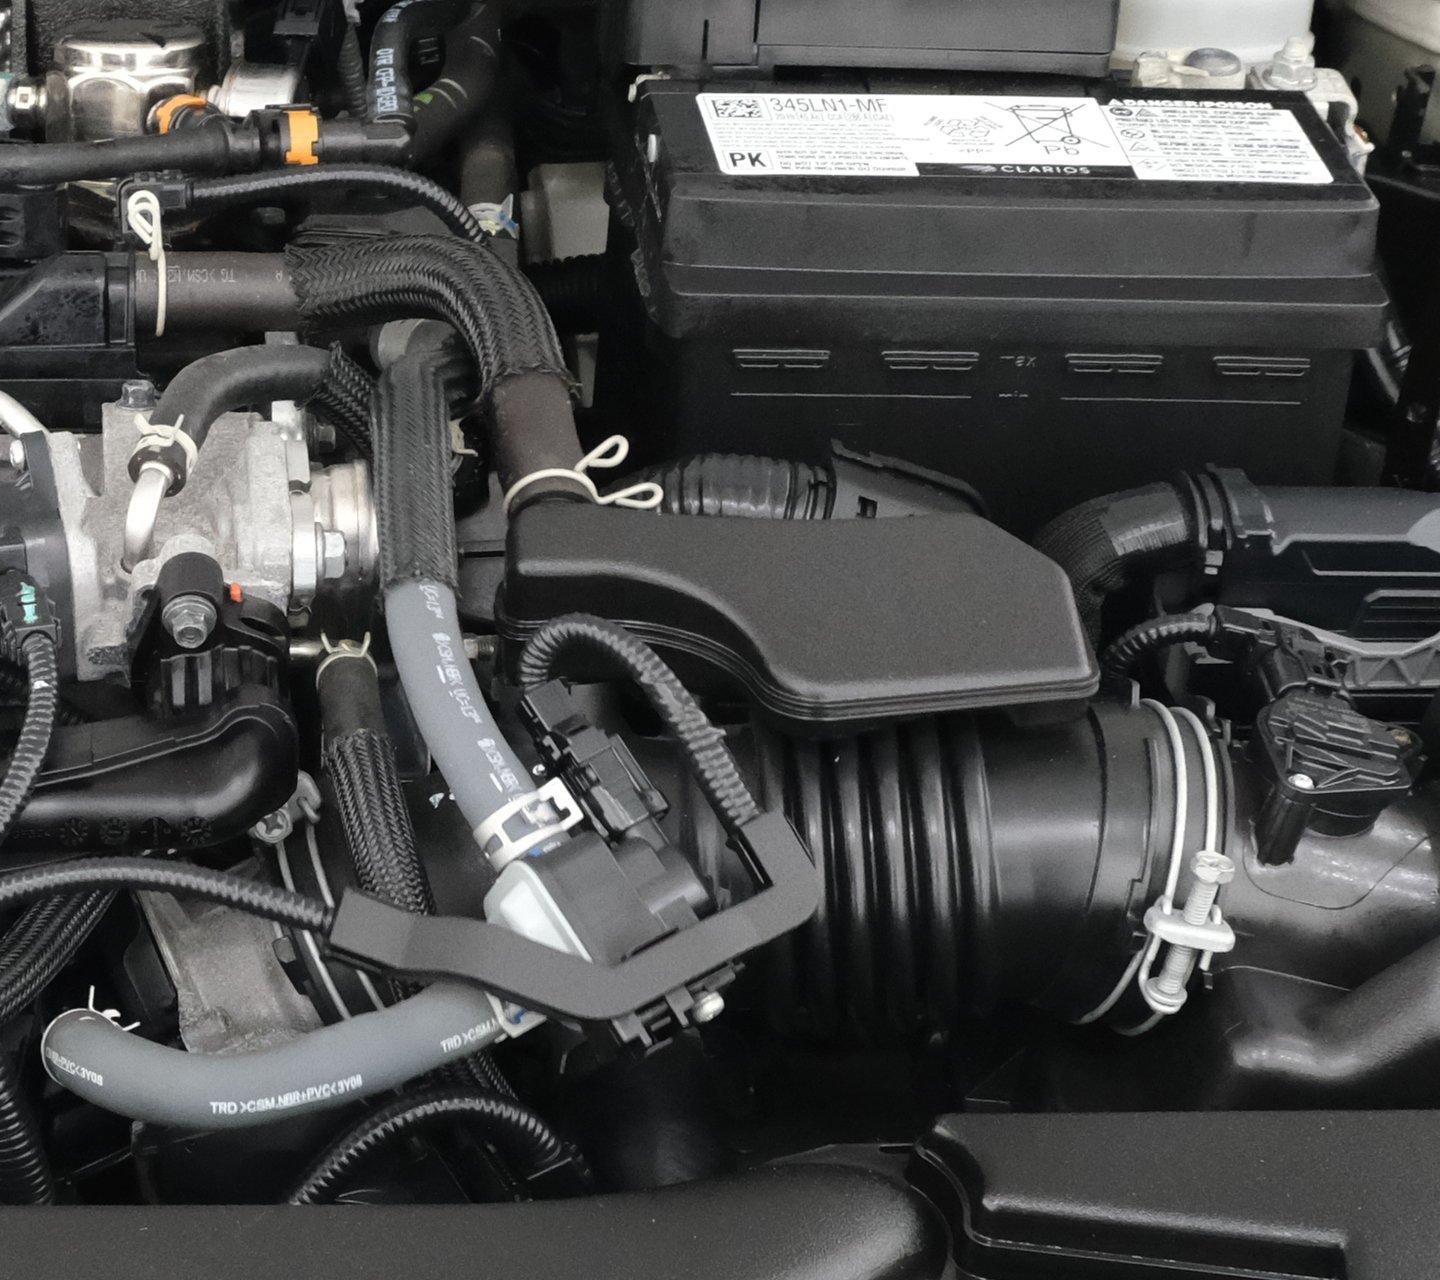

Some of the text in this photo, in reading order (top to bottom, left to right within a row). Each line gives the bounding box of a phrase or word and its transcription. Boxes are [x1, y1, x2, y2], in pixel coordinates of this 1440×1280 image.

[770, 98, 888, 113] 345LN1-MF
[1043, 145, 1080, 156] Pb
[729, 152, 767, 168] PK
[1000, 165, 1091, 175] CLARIOS
[209, 1101, 238, 1115] TRD
